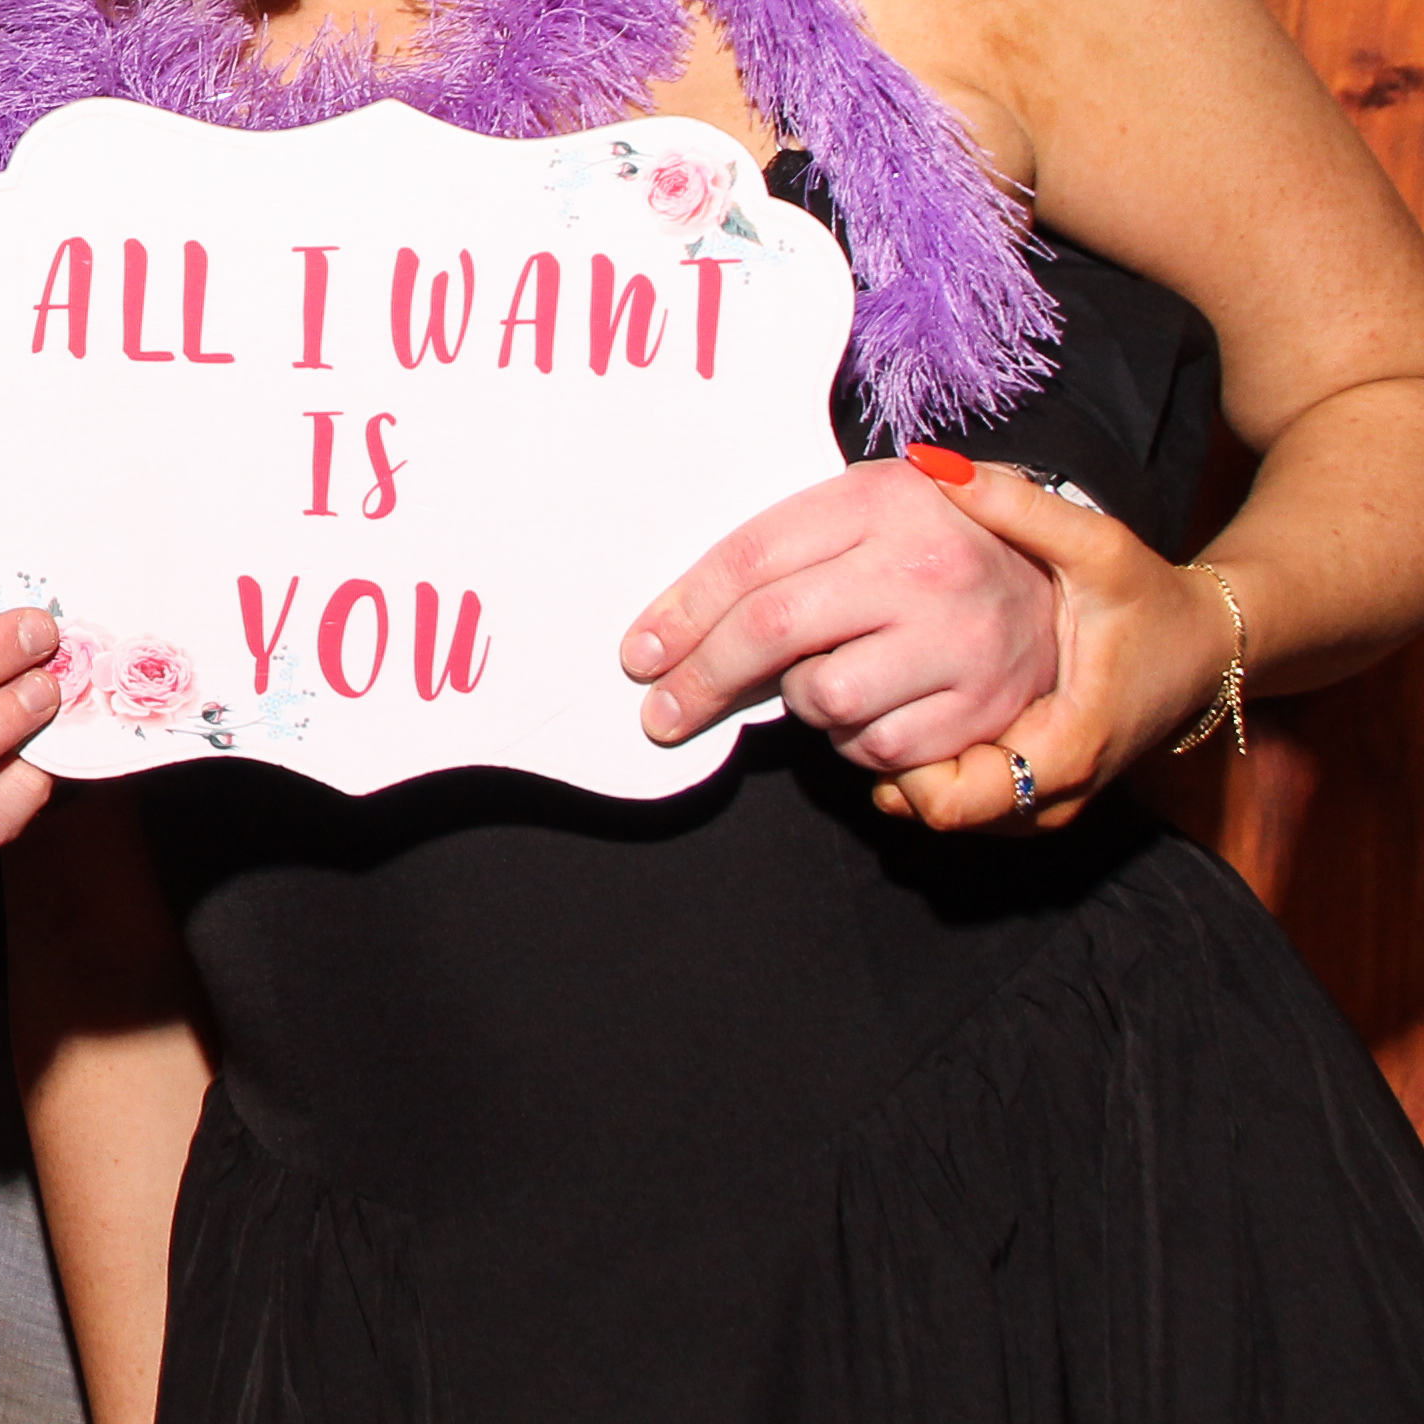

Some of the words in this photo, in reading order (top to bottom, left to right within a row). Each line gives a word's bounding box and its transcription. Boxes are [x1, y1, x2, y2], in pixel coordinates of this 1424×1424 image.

[31, 236, 235, 365] ALL
[291, 245, 340, 370] I
[302, 411, 408, 521] IS
[237, 574, 491, 702] YOU
